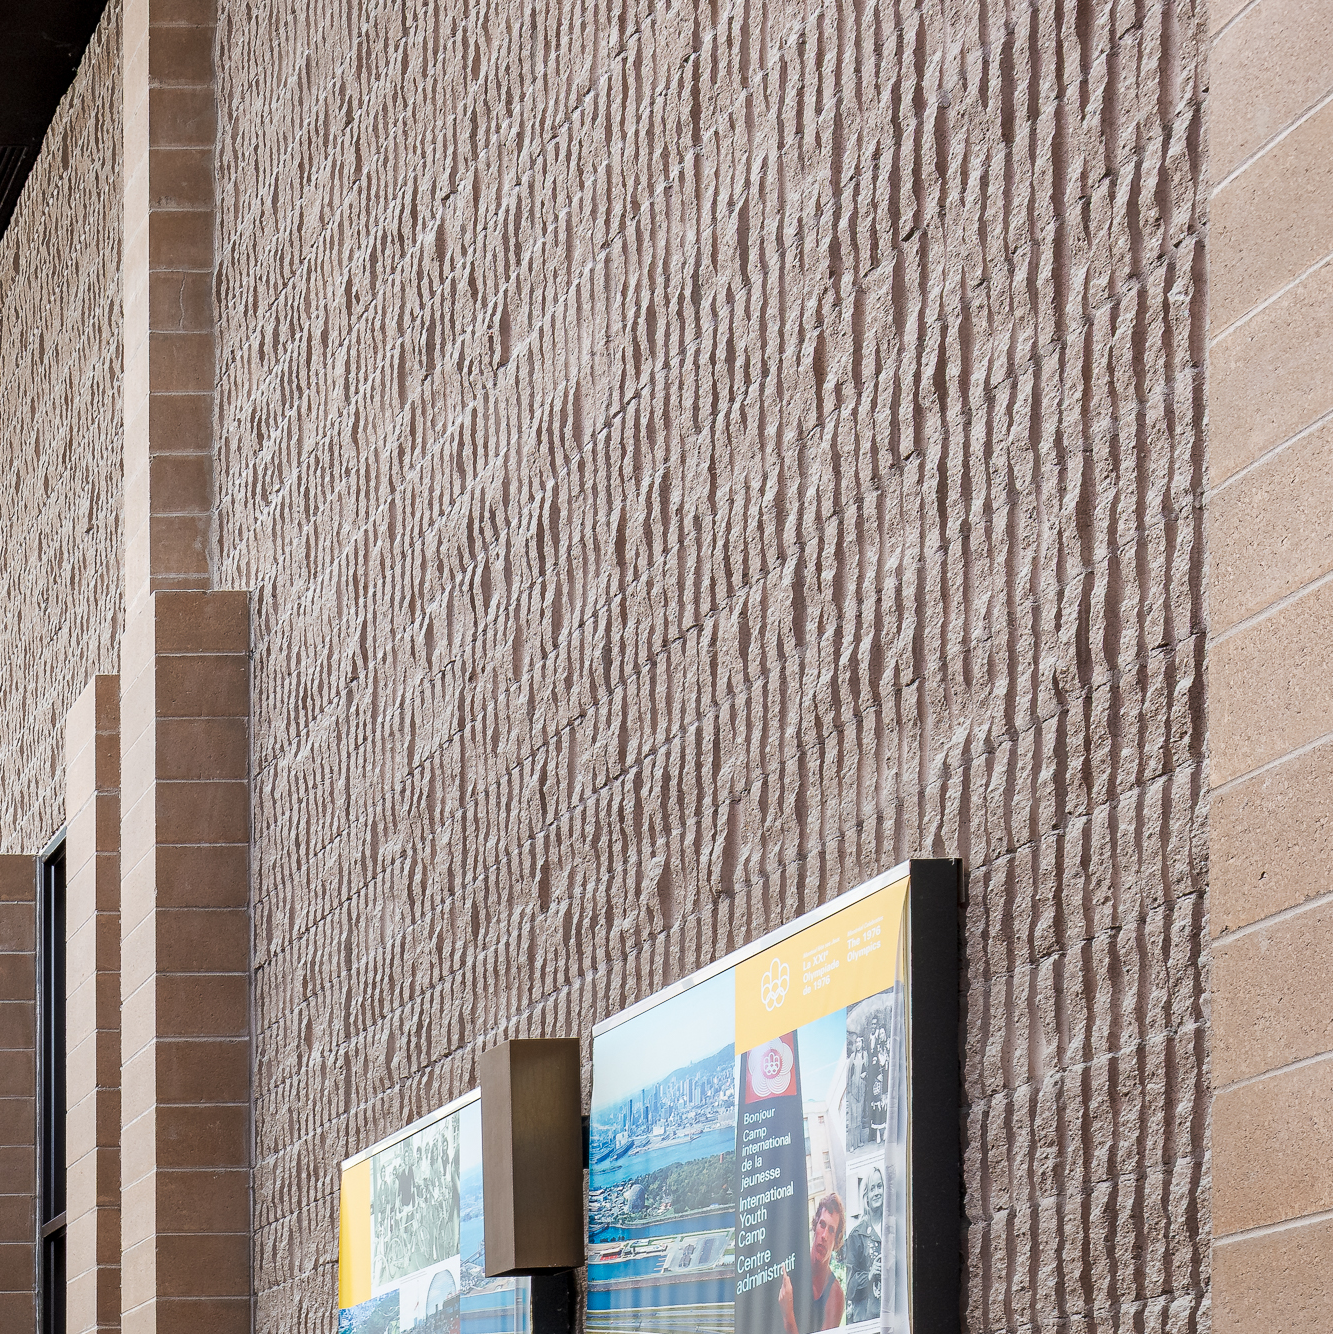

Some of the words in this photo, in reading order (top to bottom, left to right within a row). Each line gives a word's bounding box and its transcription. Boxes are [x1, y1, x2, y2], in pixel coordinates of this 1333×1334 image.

[847, 937, 861, 949] The
[862, 925, 881, 942] 1976
[846, 940, 881, 962] Olympics
[803, 961, 811, 971] La
[803, 959, 840, 983] Olympiade
[803, 985, 811, 996] de
[813, 975, 831, 990] 1976
[743, 1108, 776, 1125] Bonjour
[742, 1132, 791, 1157] international
[743, 1127, 767, 1142] Camp
[741, 1158, 752, 1172] de
[755, 1155, 762, 1168] la
[740, 1167, 781, 1192] jeunesse
[739, 1181, 794, 1212] International
[739, 1206, 767, 1229] Youth
[738, 1227, 766, 1248] Camp
[737, 1249, 771, 1274] Centre
[736, 1253, 796, 1295] administratif
